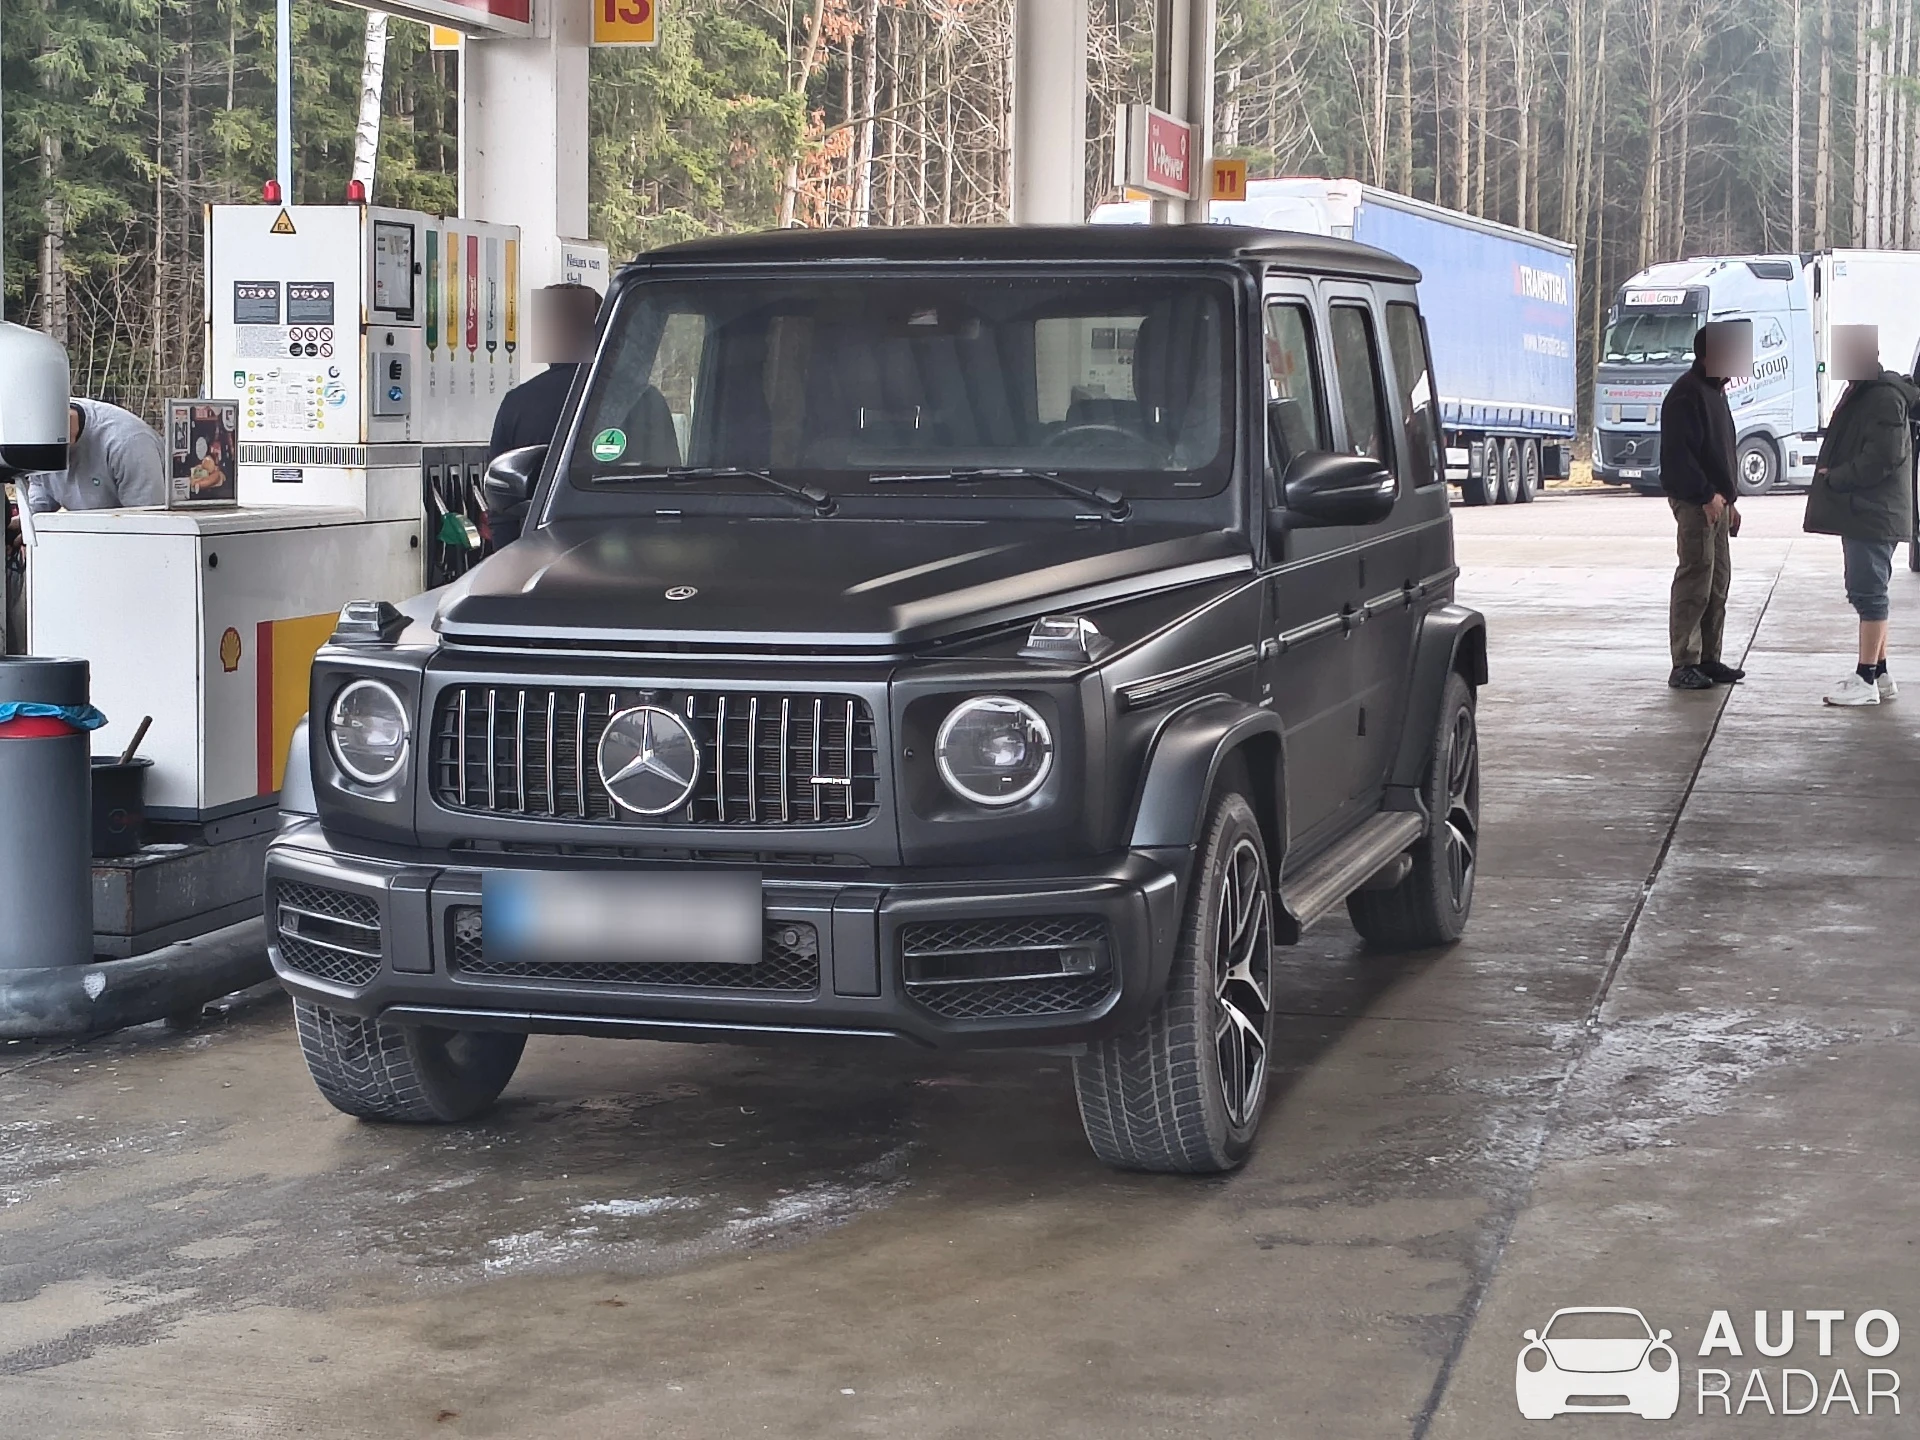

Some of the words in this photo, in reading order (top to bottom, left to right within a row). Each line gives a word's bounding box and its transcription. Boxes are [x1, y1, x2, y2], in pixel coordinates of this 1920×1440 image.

[604, 0, 650, 24] 13
[1152, 140, 1184, 181] V-Power
[1216, 169, 1237, 193] 11
[1520, 265, 1568, 306] TRANSTIRA
[1752, 355, 1788, 380] Group
[605, 430, 615, 445] 4
